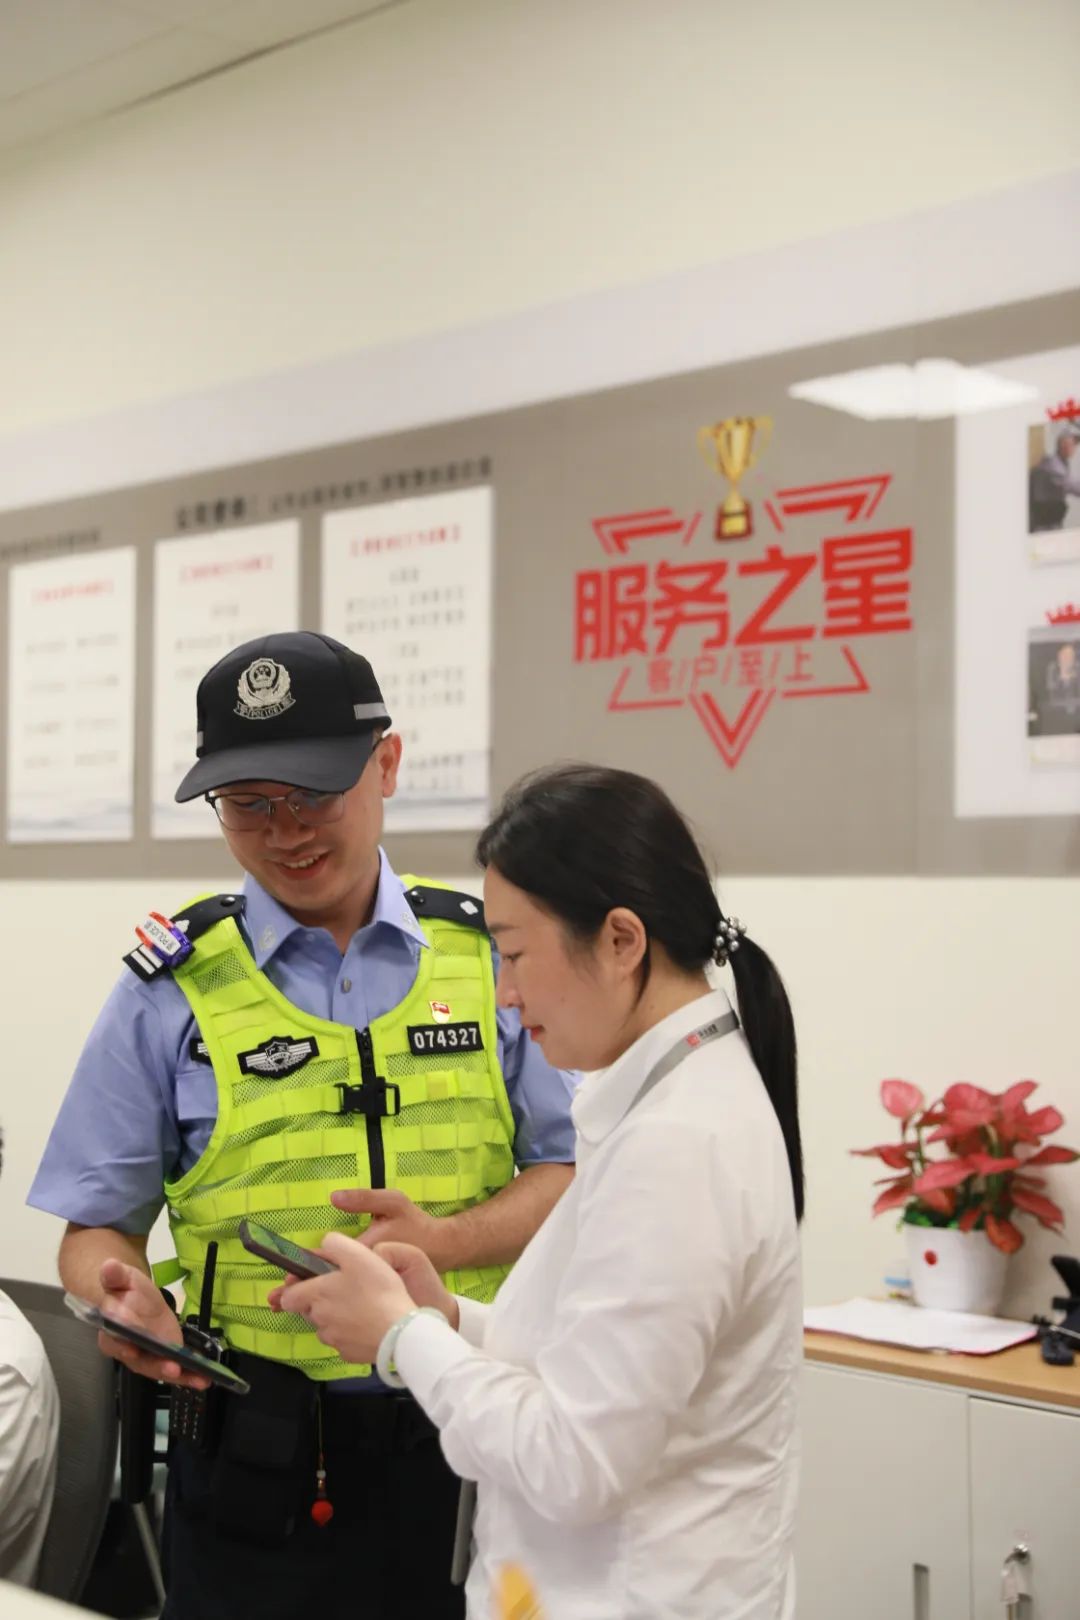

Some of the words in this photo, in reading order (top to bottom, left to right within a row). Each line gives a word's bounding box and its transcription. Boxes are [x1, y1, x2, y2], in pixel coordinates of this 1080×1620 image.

[575, 528, 912, 662] 服务之星
[414, 1027, 477, 1049] 074327
